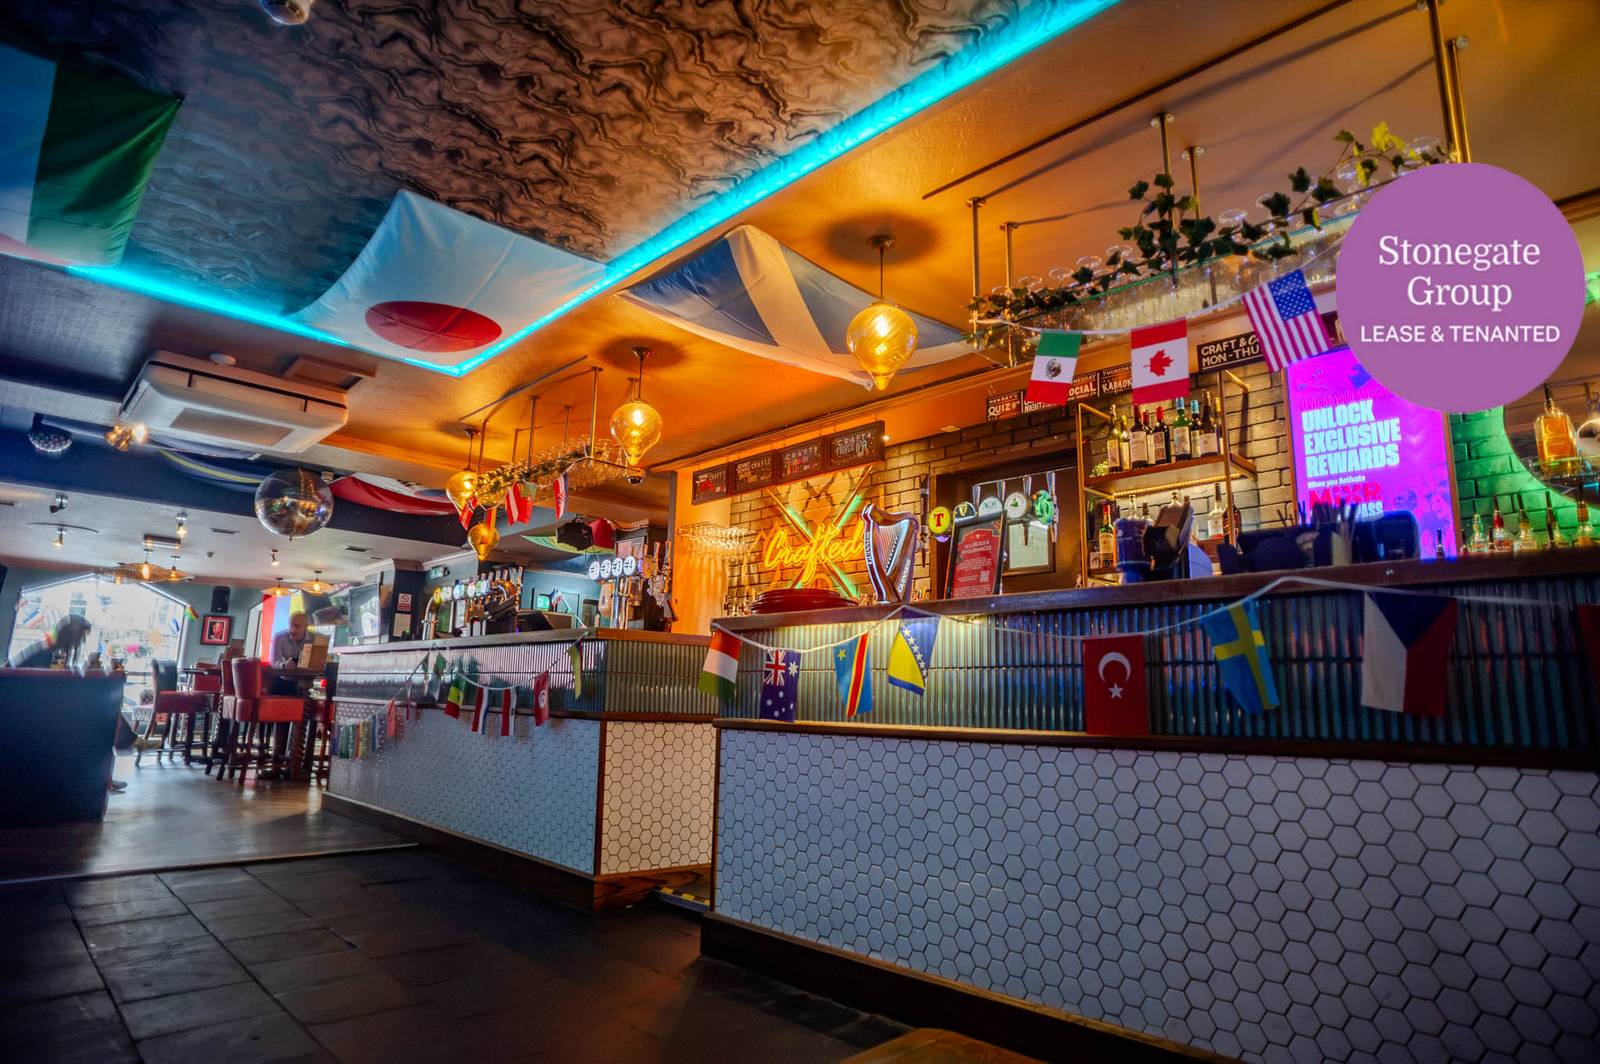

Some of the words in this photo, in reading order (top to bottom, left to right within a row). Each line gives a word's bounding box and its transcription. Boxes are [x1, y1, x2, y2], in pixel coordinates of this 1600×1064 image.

[1201, 339, 1237, 356] CRAFT
[1240, 337, 1247, 347] &
[1068, 381, 1097, 397] OCIAL
[1102, 377, 1133, 393] KARAOK
[987, 403, 1011, 418] QUIZ
[1301, 399, 1375, 432] UNLOCK
[1304, 418, 1401, 455] EXCLUSIVE
[1306, 443, 1399, 477] REWARDS
[764, 519, 864, 586] Crafted
